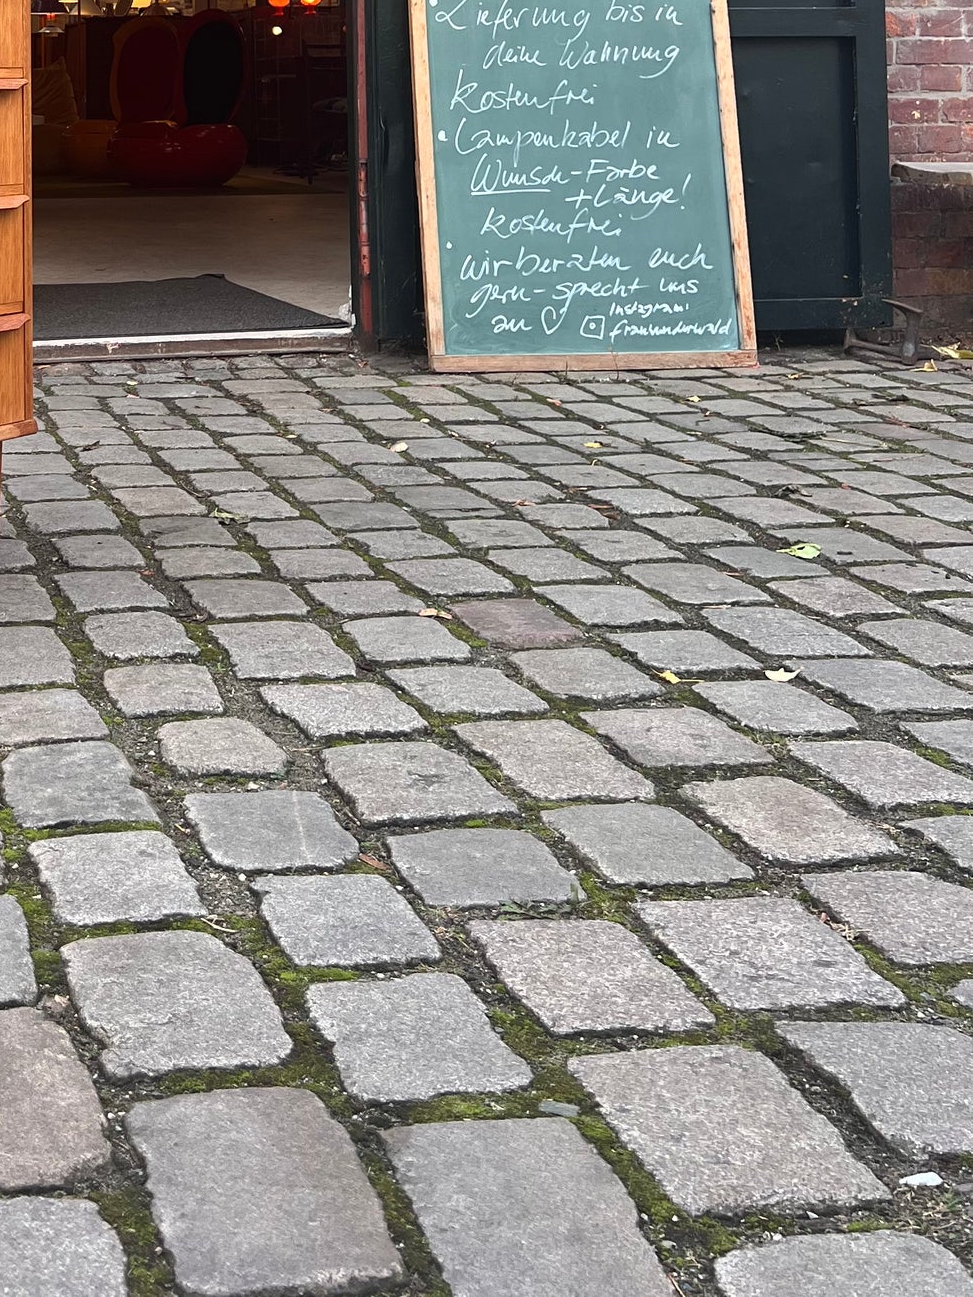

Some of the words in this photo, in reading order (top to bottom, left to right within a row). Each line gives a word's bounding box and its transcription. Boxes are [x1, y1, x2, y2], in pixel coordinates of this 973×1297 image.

[655, 3, 683, 26] in
[482, 40, 547, 70] deine
[646, 126, 681, 149] in
[647, 243, 715, 270] euch
[658, 277, 700, 295] uns
[491, 314, 533, 334] an
